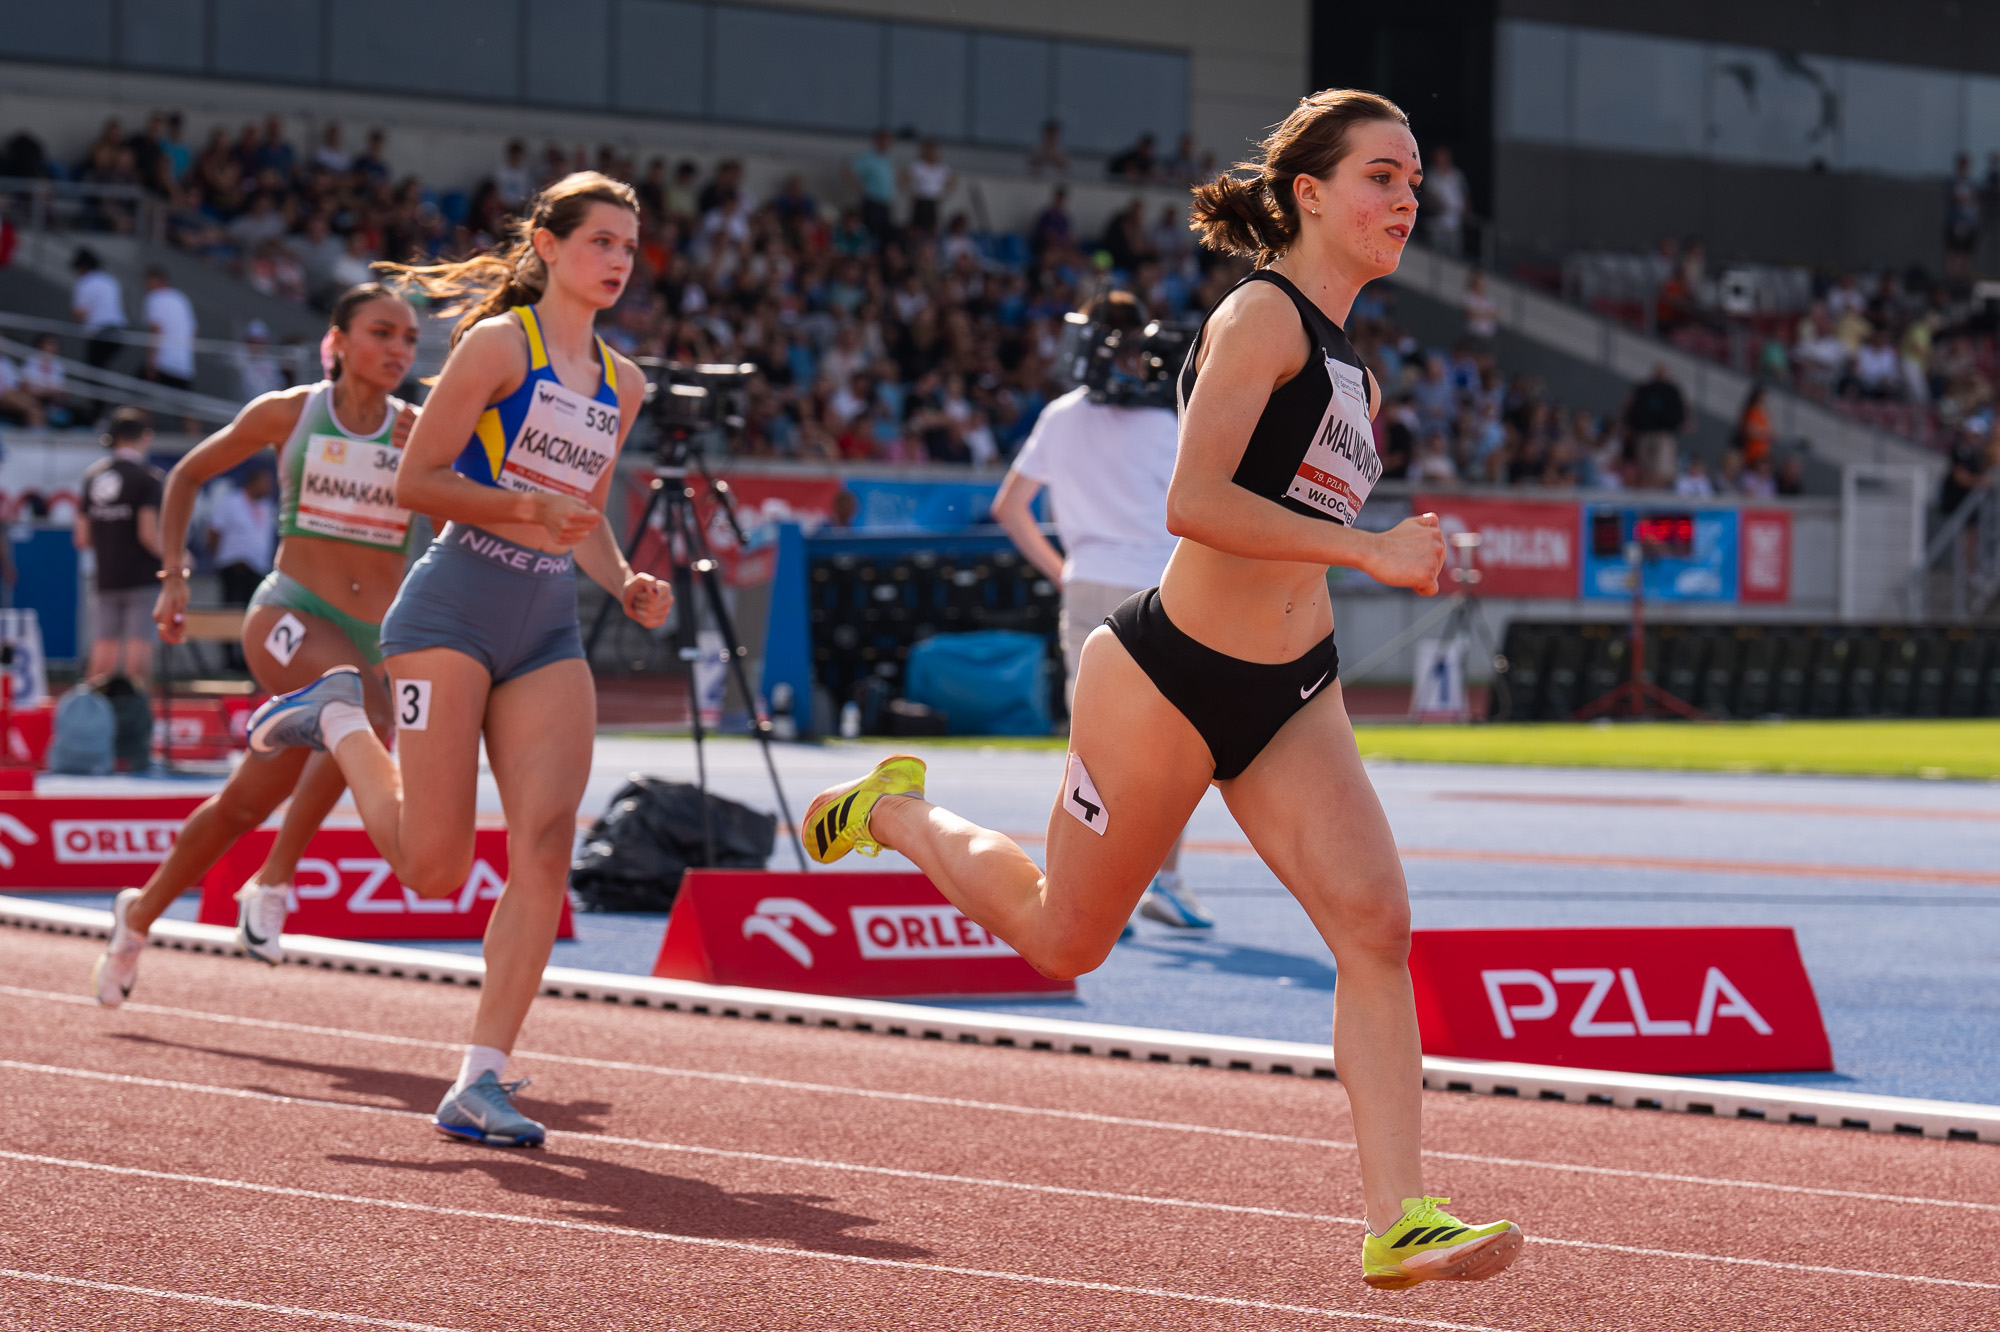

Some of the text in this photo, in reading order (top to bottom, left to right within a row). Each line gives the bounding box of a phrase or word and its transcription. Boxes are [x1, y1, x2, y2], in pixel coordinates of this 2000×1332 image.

[585, 406, 618, 436] 530
[1313, 470, 1342, 491] 79. PZLA
[458, 529, 533, 571] NIKE
[274, 626, 303, 656] 2
[402, 684, 420, 725] 3
[1480, 966, 1775, 1039] PZLA
